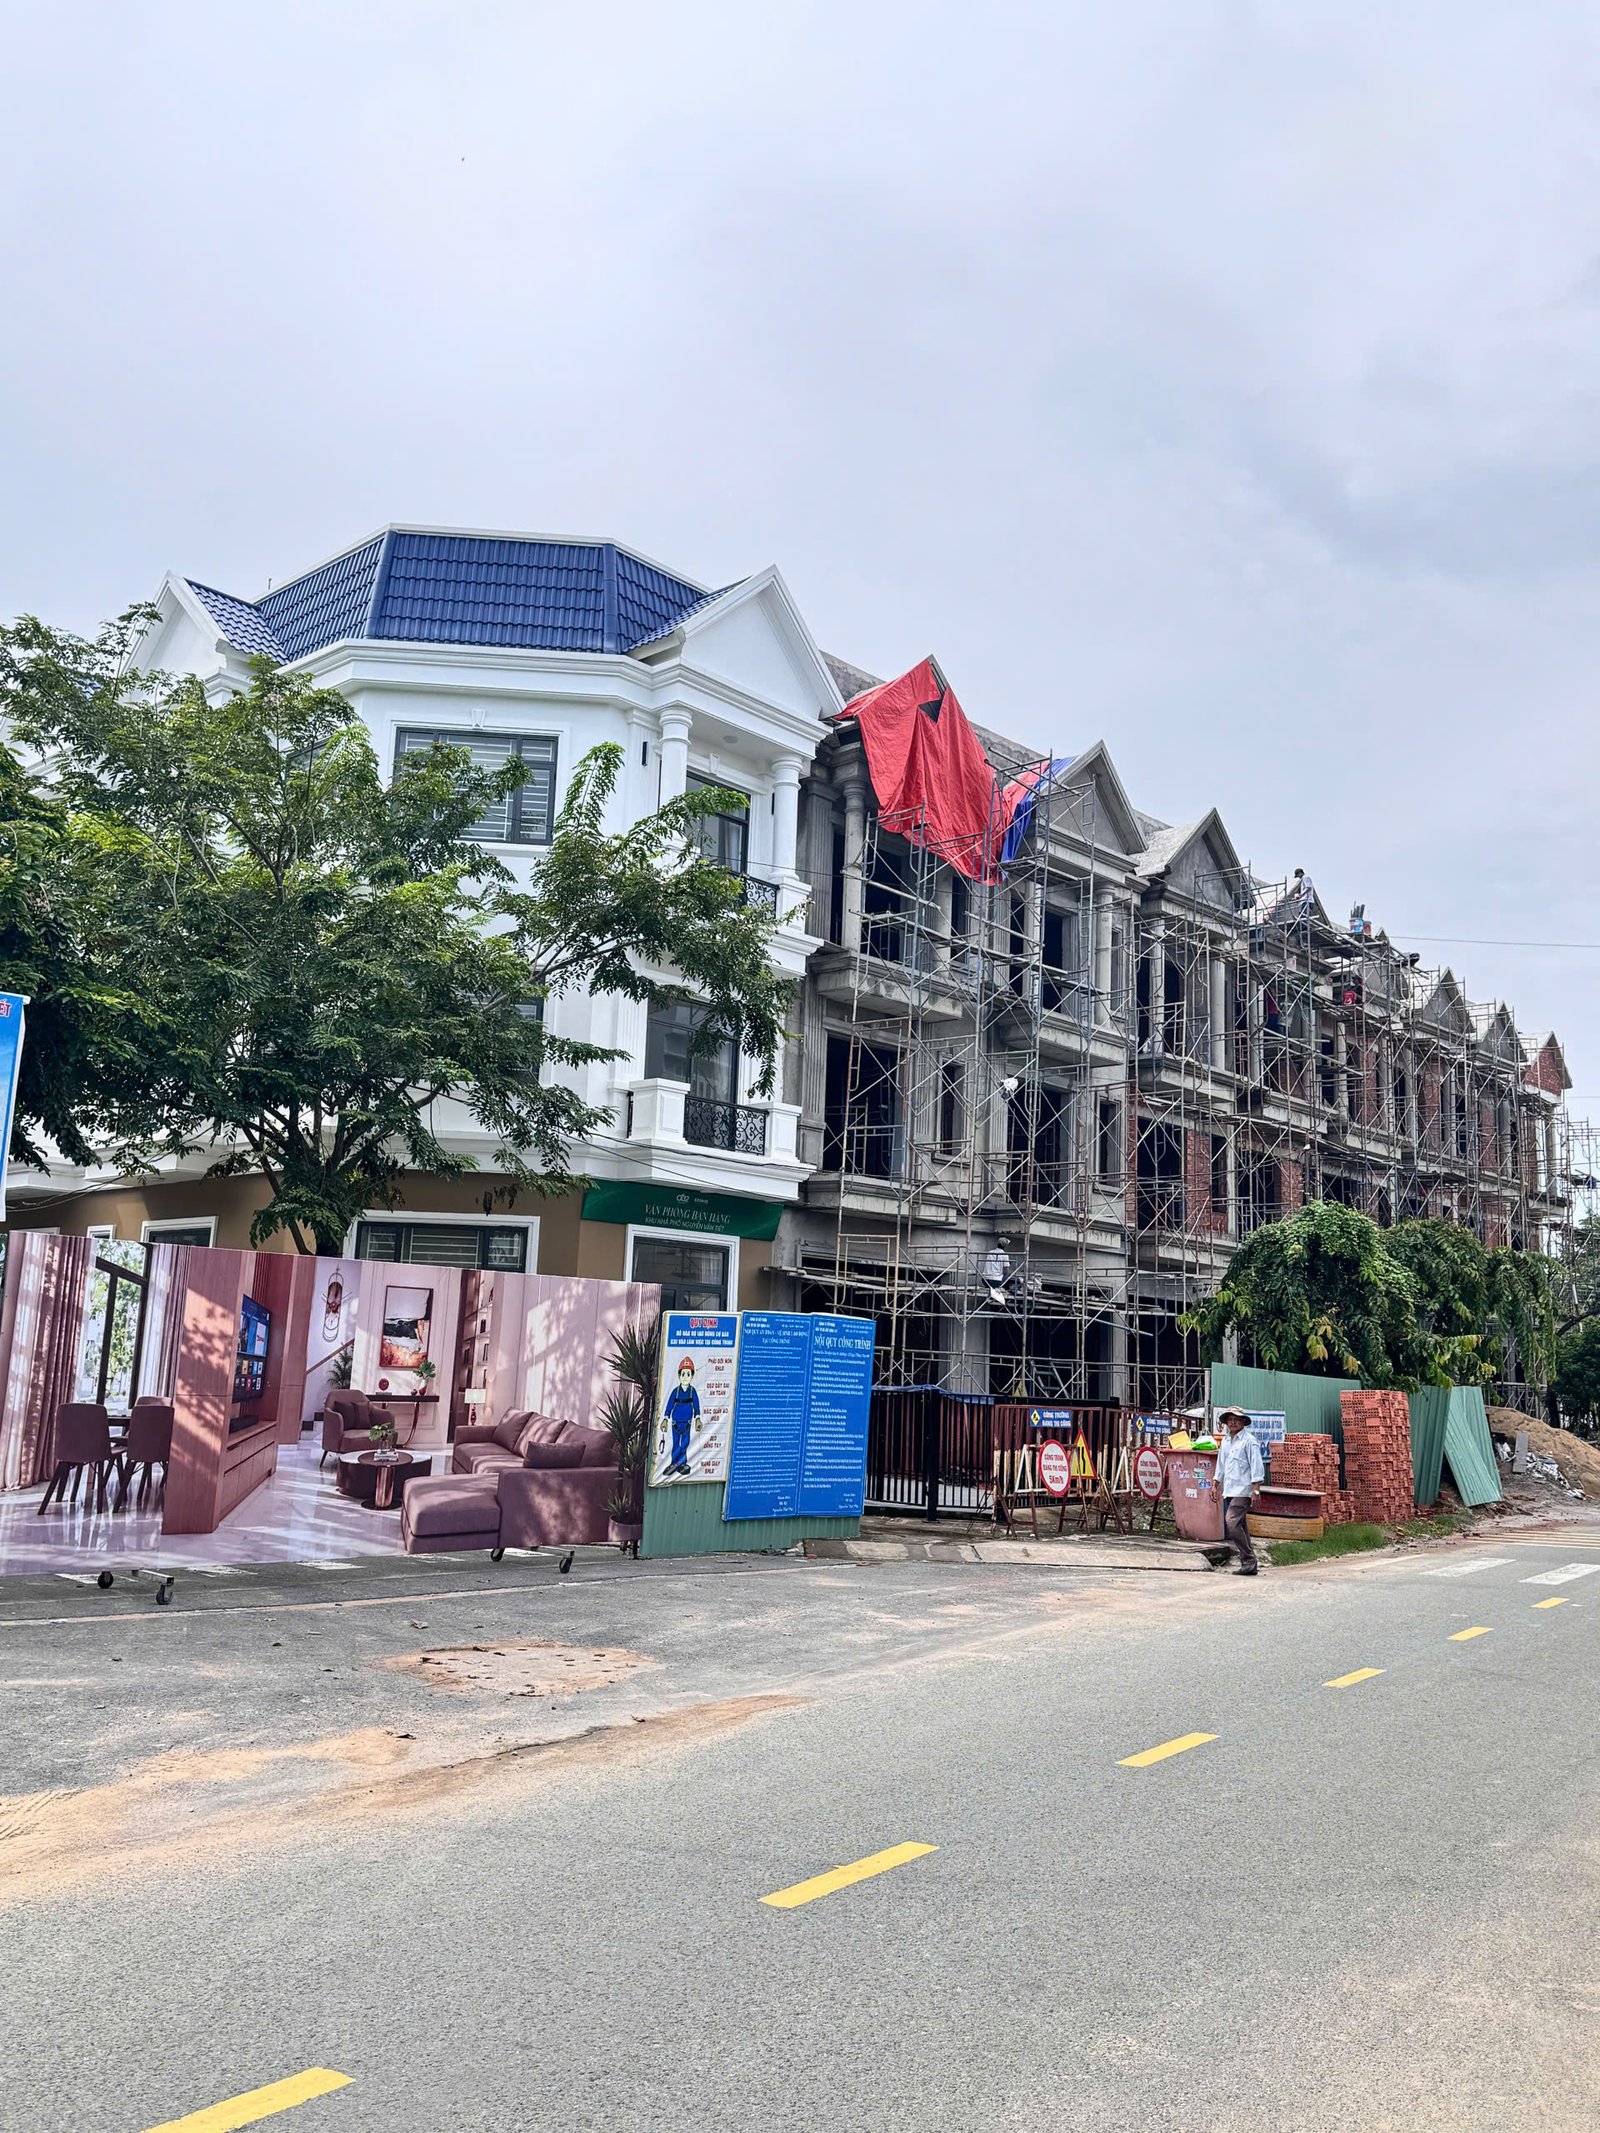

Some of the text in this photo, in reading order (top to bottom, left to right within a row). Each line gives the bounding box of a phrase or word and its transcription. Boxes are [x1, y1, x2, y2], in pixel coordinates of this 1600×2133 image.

[645, 1204, 661, 1216] VĂN
[662, 1206, 691, 1219] PHÒNG
[708, 1212, 731, 1224] HÀNG
[690, 1317, 702, 1329] QUY
[814, 1334, 872, 1350] NỘI QUY CÔNG TRÌNH
[1061, 1419, 1072, 1427] CÔNG
